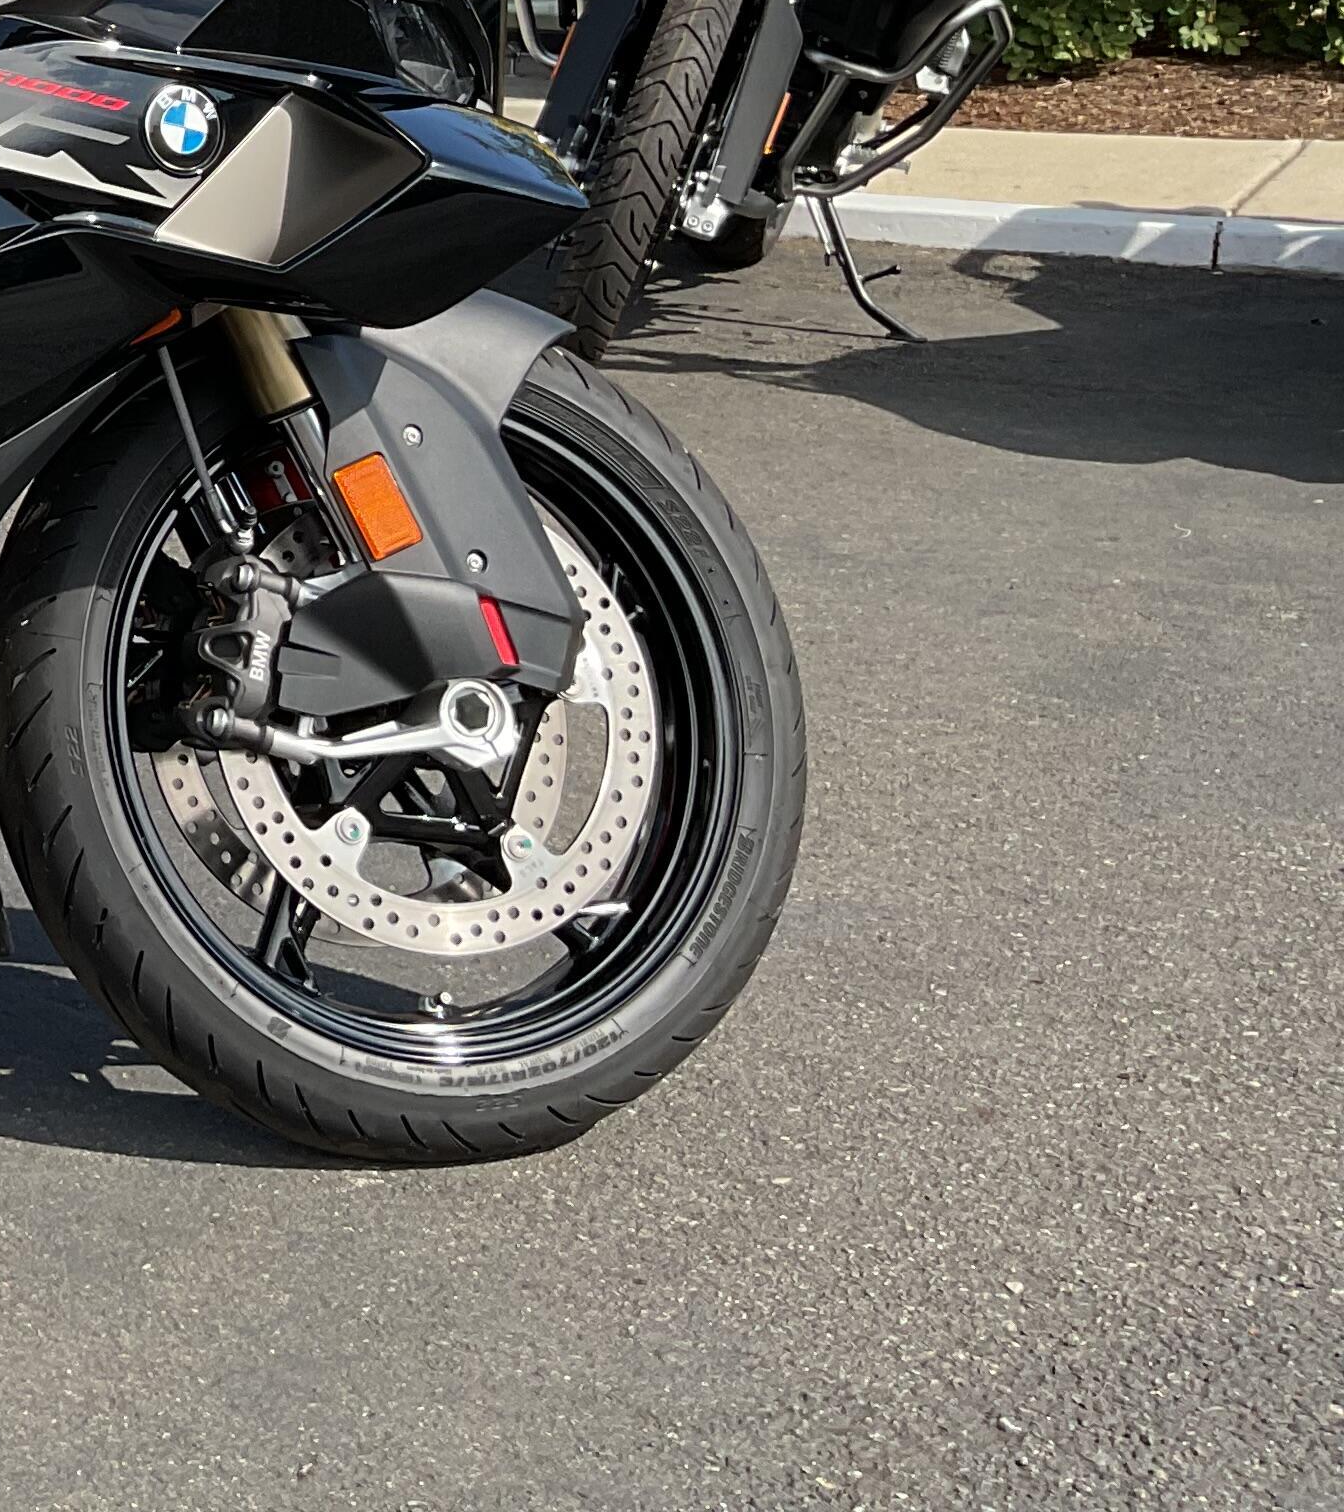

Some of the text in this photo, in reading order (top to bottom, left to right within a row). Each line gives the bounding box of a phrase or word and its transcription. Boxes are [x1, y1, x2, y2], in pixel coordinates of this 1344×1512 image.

[156, 87, 218, 121] BMW
[249, 629, 271, 682] BMW
[689, 832, 755, 960] BRIDGESTONE
